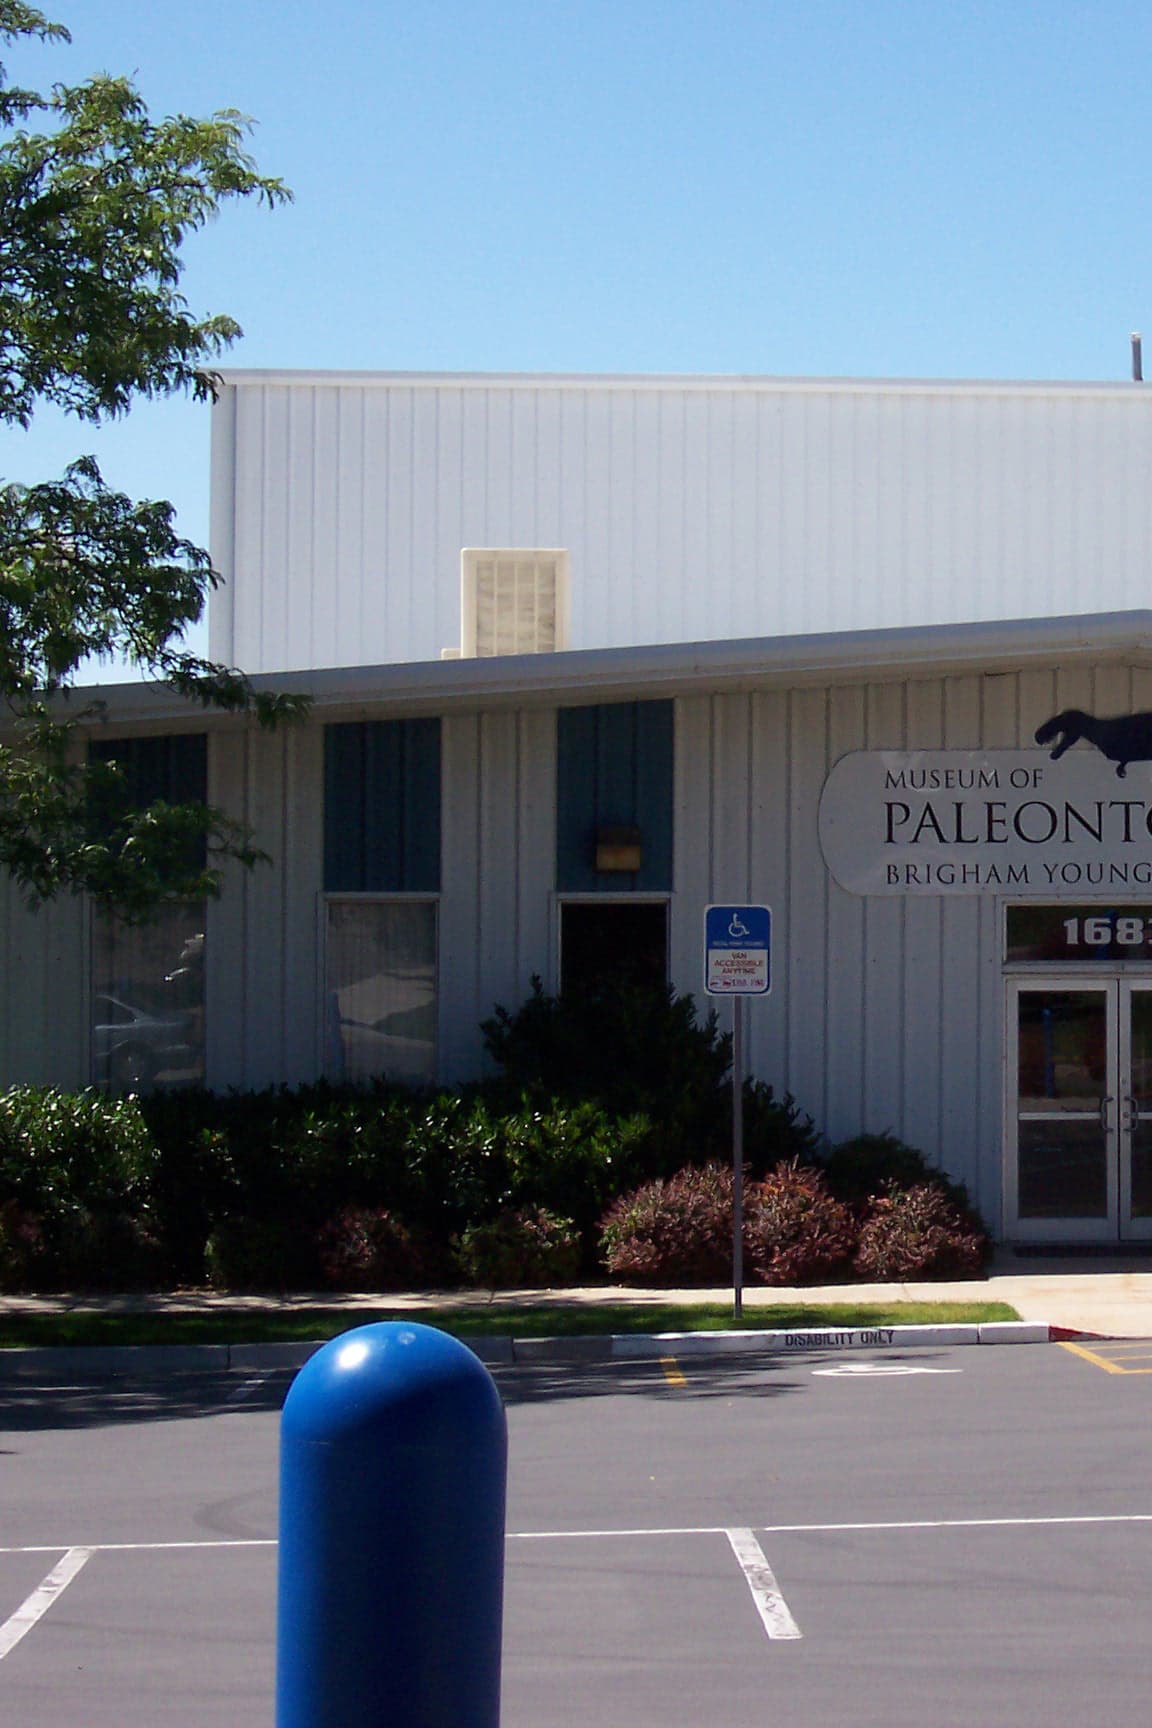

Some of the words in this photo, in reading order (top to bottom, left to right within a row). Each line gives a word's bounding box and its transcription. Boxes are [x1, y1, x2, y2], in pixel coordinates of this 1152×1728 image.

[884, 768, 1001, 790] MUSEUM
[1010, 768, 1044, 789] OF
[886, 863, 1030, 885] BRIGHAM
[1043, 862, 1152, 884] YOUNG
[731, 952, 748, 960] VAN
[714, 959, 763, 967] ACCESSIBLE
[721, 967, 756, 975] ANYTIME
[860, 1329, 895, 1345] ONLY
